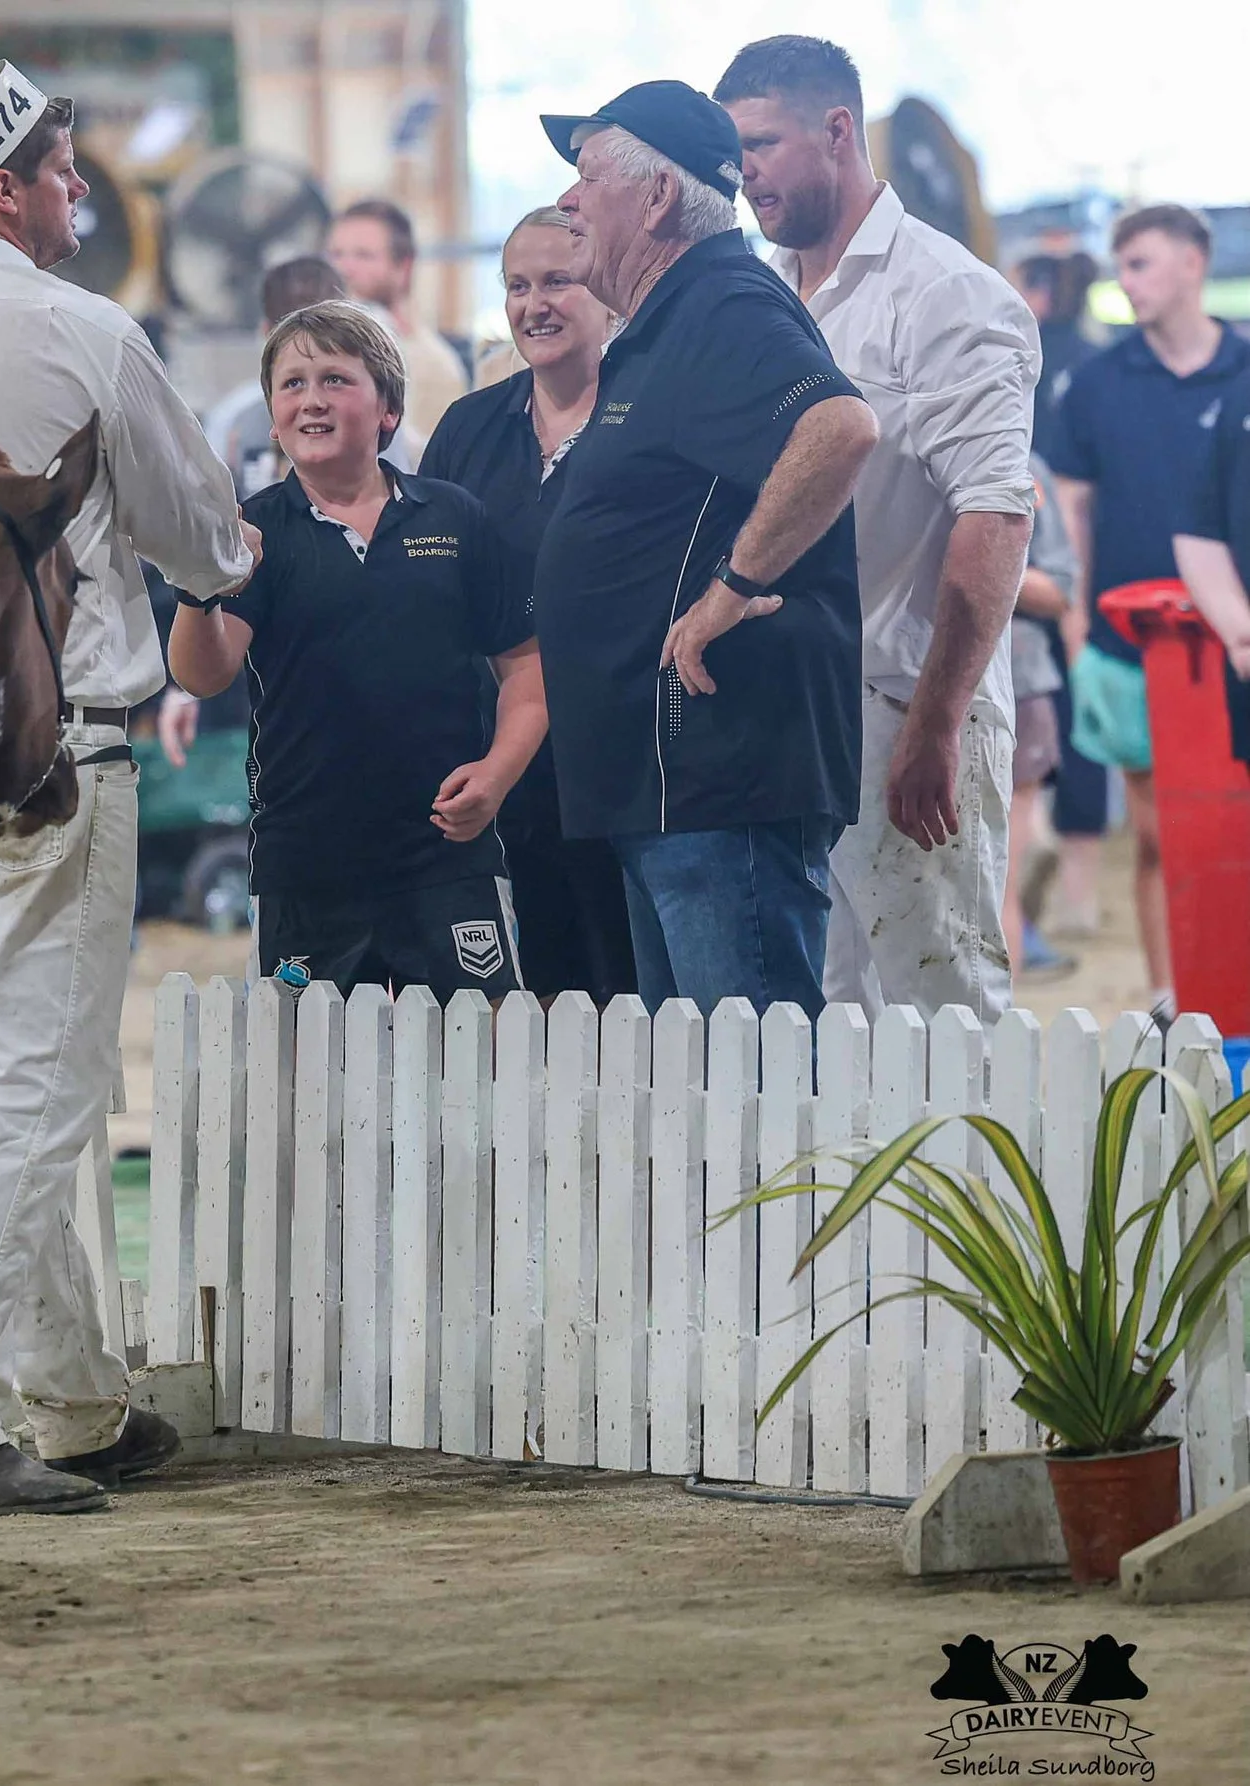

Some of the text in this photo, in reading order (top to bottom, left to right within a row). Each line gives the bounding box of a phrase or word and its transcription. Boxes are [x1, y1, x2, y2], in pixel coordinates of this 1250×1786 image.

[402, 536, 459, 546] SHOWCASE
[407, 548, 458, 558] BOARDING
[461, 930, 492, 943] NRL
